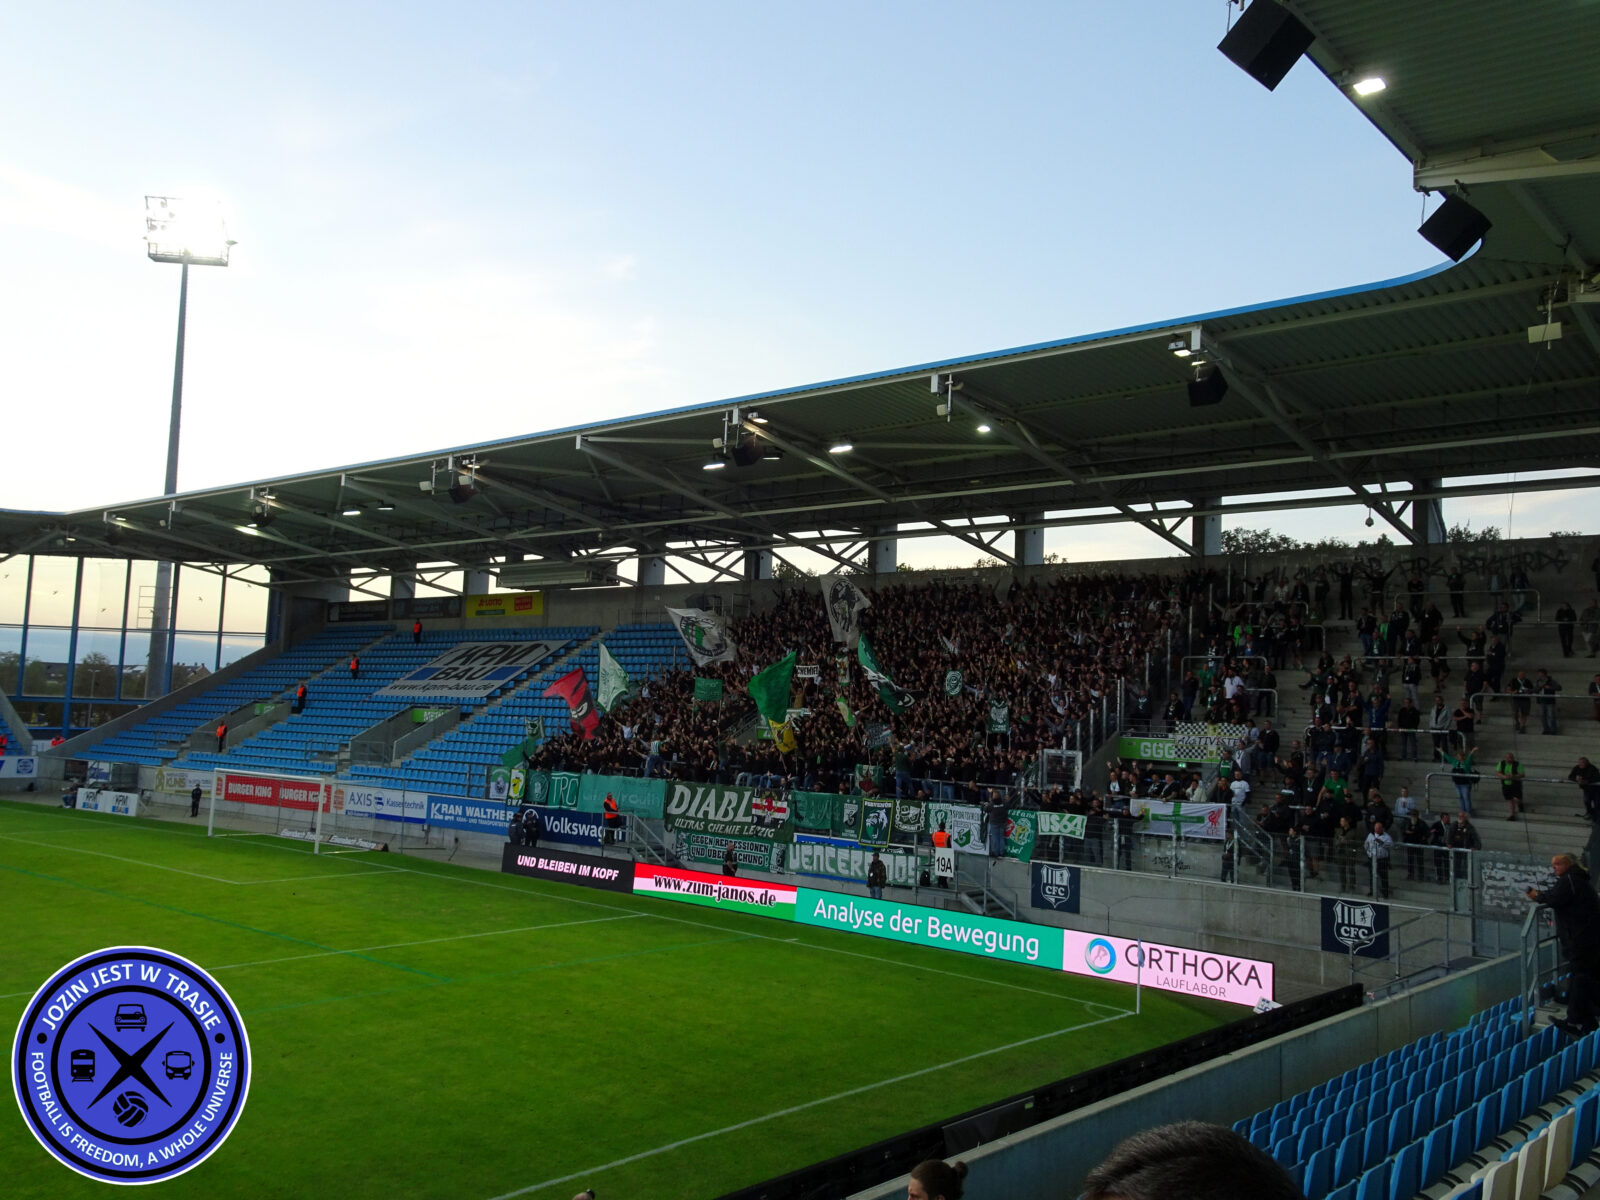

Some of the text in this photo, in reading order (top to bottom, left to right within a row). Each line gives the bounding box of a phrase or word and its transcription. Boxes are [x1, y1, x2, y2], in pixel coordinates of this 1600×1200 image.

[427, 666, 498, 681] BAU
[389, 682, 495, 693] www.kpm-bau.de
[228, 782, 254, 796] BURGER
[255, 785, 273, 798] KING
[308, 790, 328, 804] KIG
[348, 791, 372, 806] AXIS
[551, 775, 579, 807] TRC
[430, 802, 463, 820] KRAN
[465, 806, 515, 822] WALTHER
[666, 784, 790, 823] DIABL
[544, 815, 622, 842] Volkswagn
[674, 818, 705, 831] ULTRAS
[707, 822, 742, 834] CHEMIE
[1040, 813, 1083, 836] US64
[691, 834, 769, 854] GEGEN REPESSIONEN
[691, 846, 706, 857] UND
[707, 848, 763, 866] ÜBEACHUNG
[936, 856, 953, 874] 19A
[517, 854, 620, 882] UND BLEIBEN IM KOPF
[653, 874, 777, 908] www.zum-janos.de
[1045, 886, 1065, 896] CFC
[813, 897, 1040, 962] Analyse der Bewegung
[1340, 925, 1369, 939] CFC
[1125, 943, 1263, 989] ORTHOKA
[1156, 975, 1227, 998] LAUFLABOR
